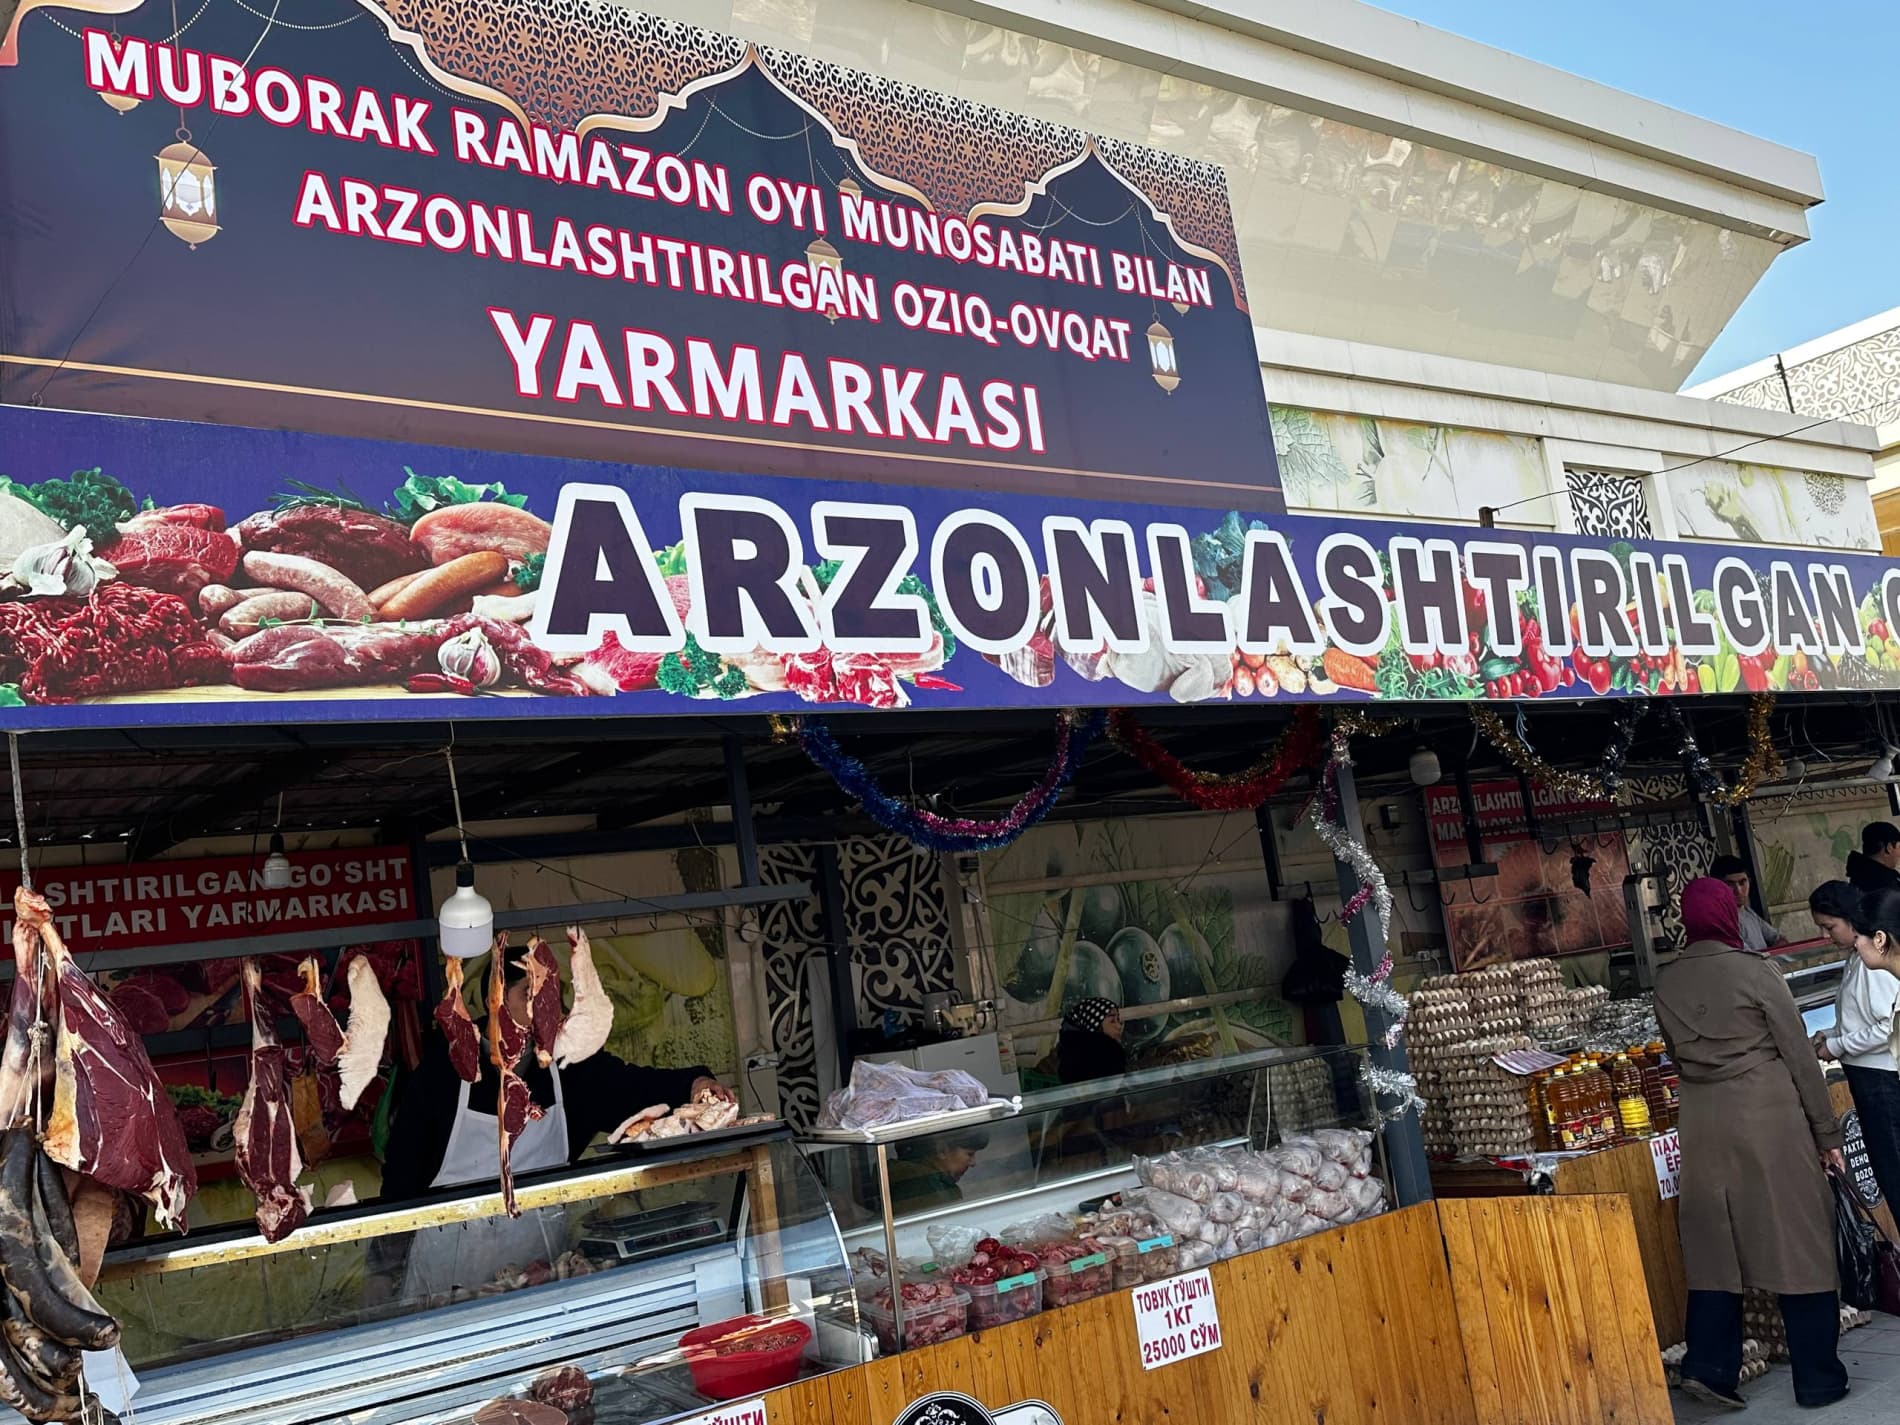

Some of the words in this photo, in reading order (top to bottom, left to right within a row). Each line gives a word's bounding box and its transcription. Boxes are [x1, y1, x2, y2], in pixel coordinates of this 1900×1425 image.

[83, 28, 437, 156] MUBORAK
[452, 107, 732, 215] RAMAZON
[746, 173, 825, 233] OYI
[841, 193, 1104, 288] MUNOSABATI
[1112, 251, 1214, 307] BILAN
[293, 171, 880, 321] ARZONLASHTIRILGAN
[892, 281, 1132, 362] OZIQ-OVQAT
[487, 307, 1047, 453] YARMARKASI
[530, 482, 1866, 658] ARZONLASHTIRILGAN
[180, 887, 409, 929] YARMARKASI
[1143, 1332, 1186, 1364] 25000
[1190, 1322, 1219, 1350] СЎМ
